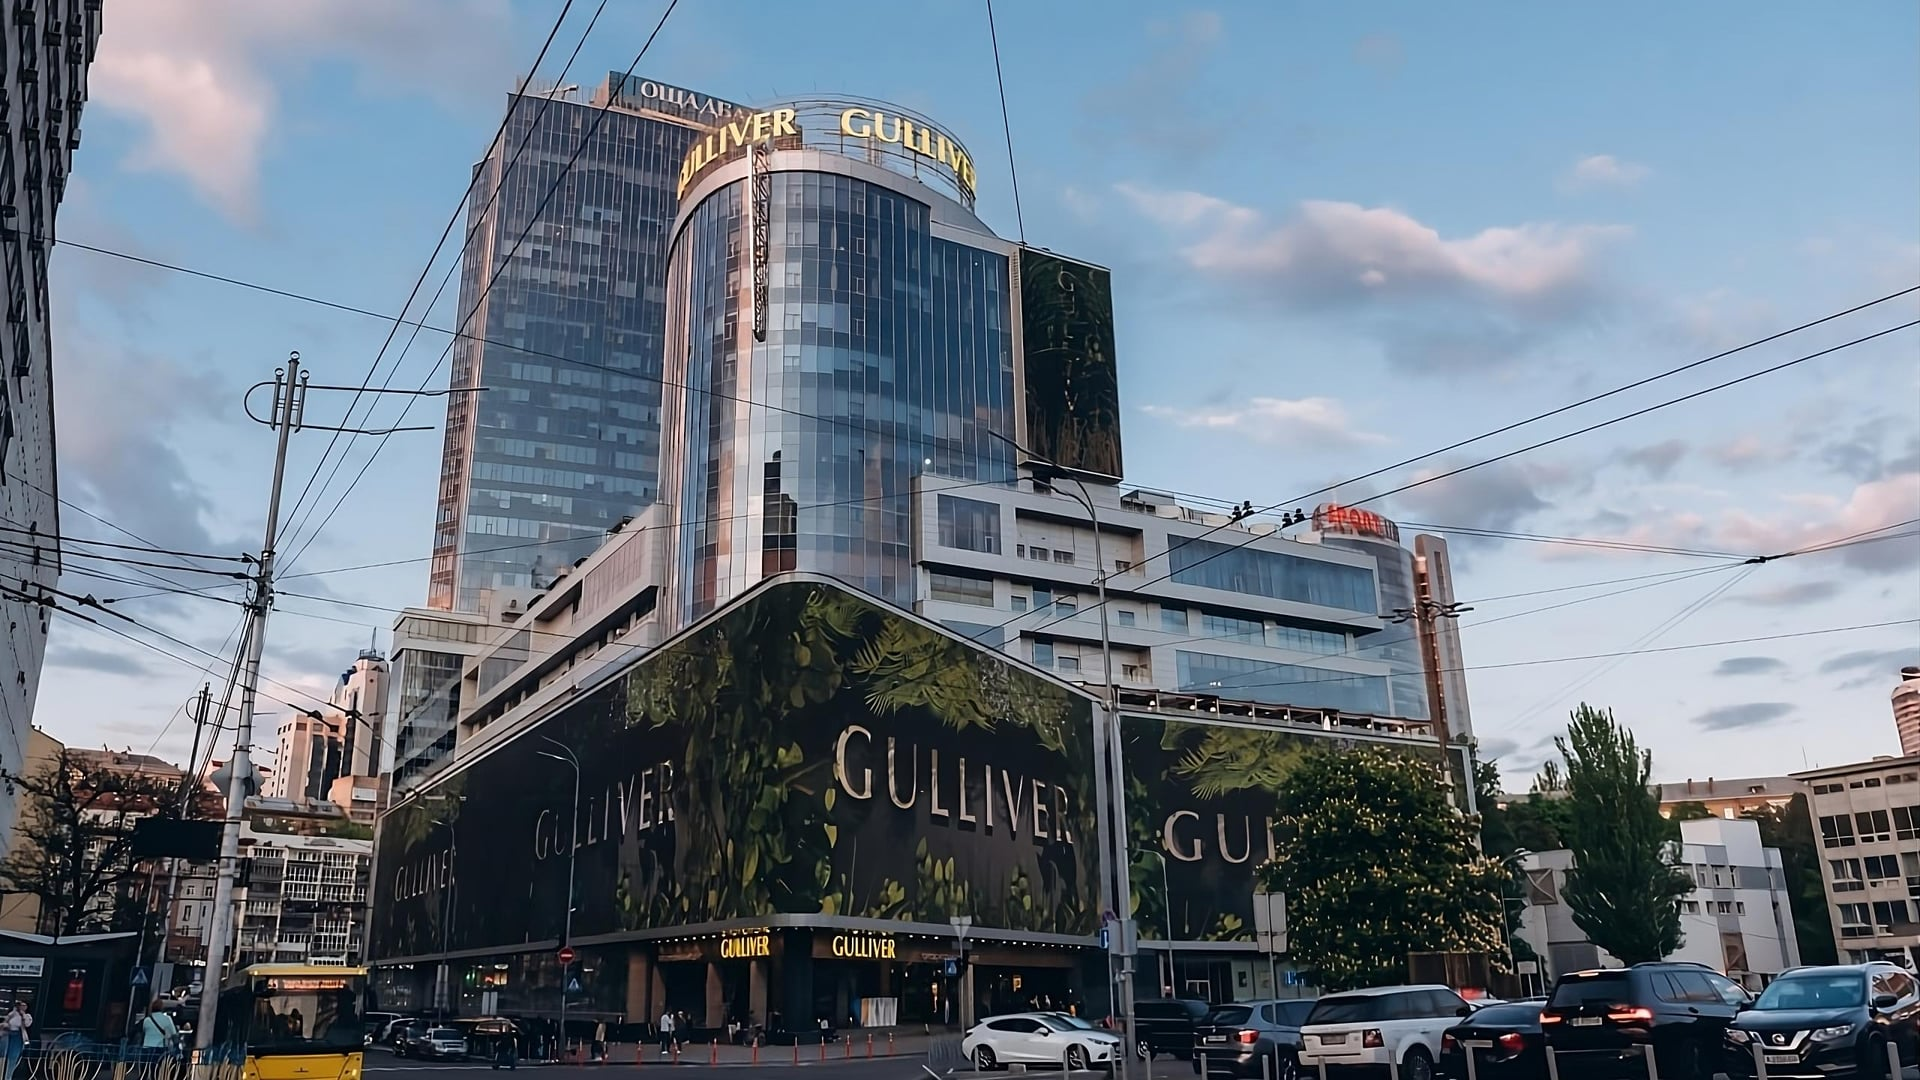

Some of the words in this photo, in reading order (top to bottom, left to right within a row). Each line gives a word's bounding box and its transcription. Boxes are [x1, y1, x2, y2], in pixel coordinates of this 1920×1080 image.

[836, 725, 1074, 845] GULLIVER
[721, 936, 769, 958] GULLIVER
[832, 936, 896, 959] GULLIVER
